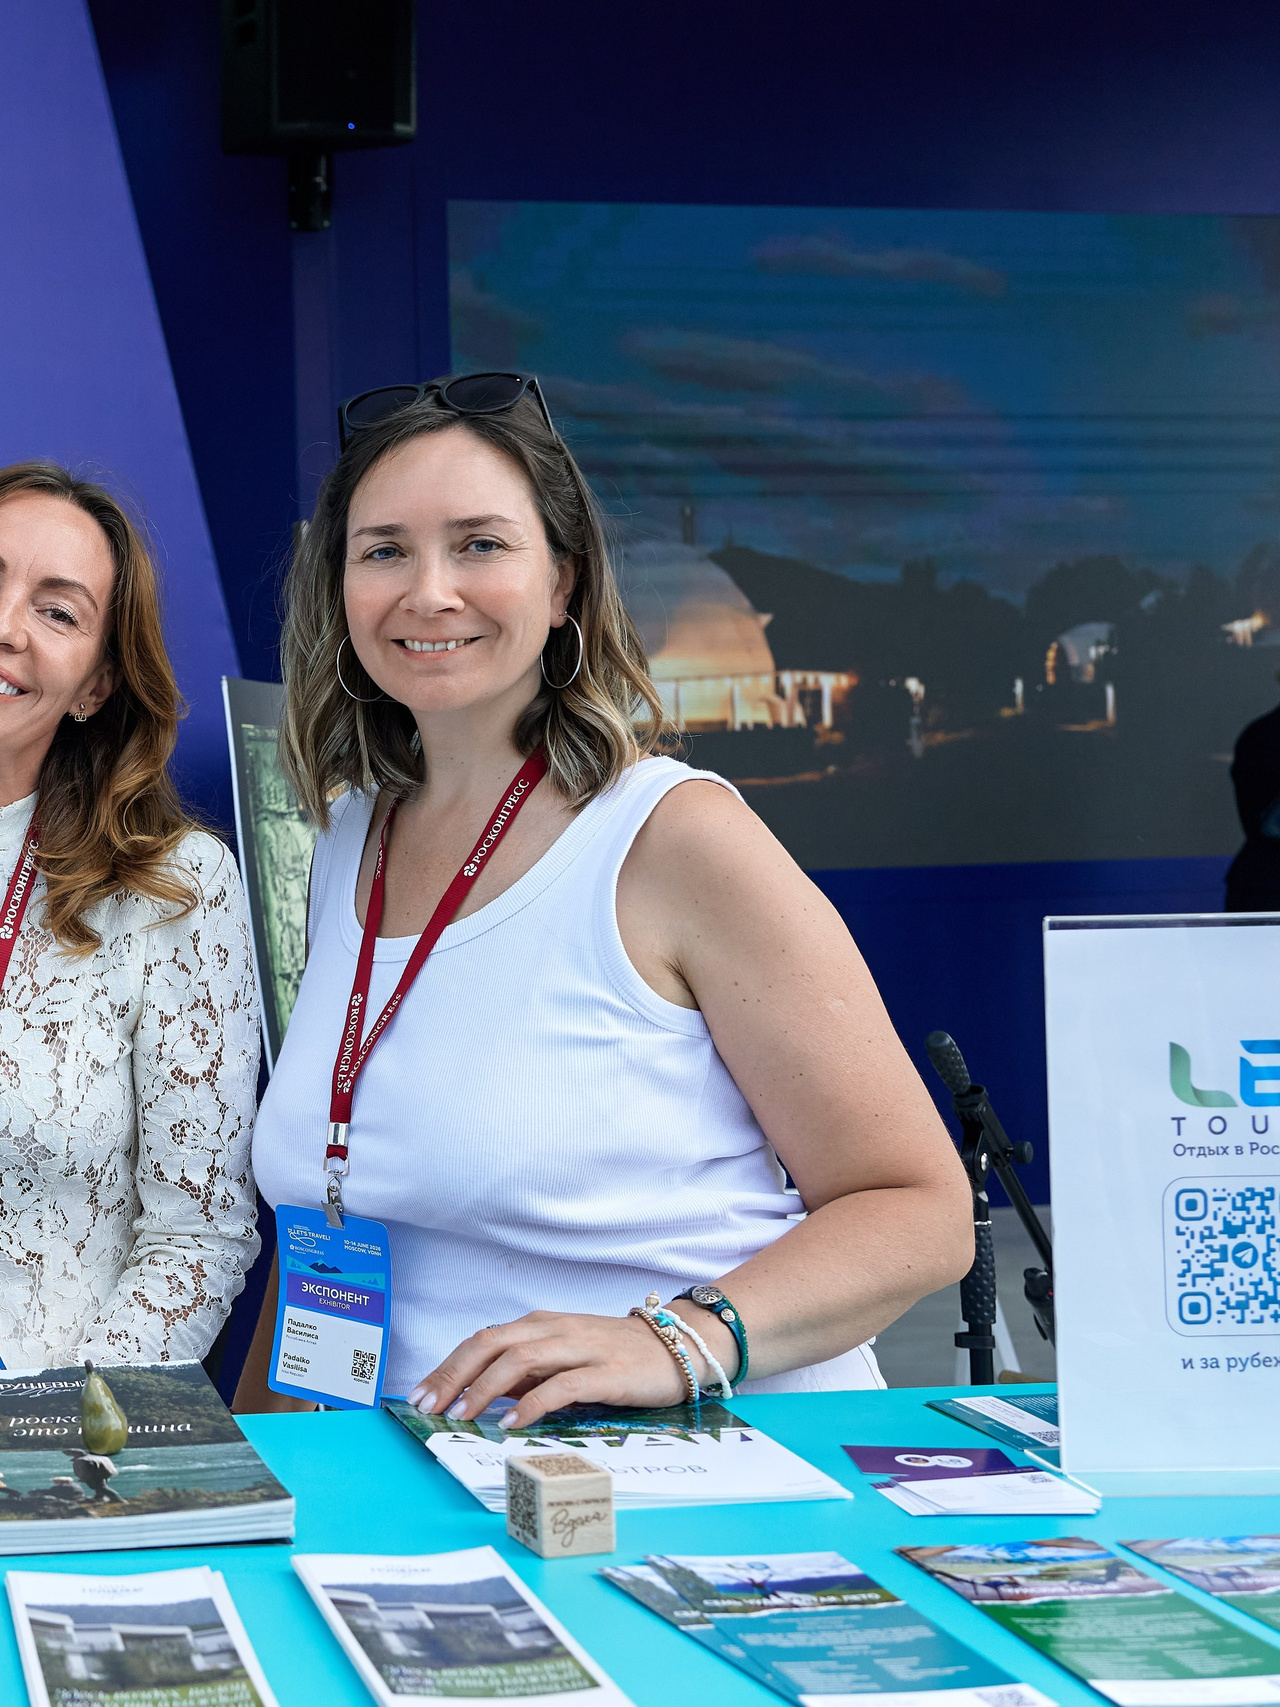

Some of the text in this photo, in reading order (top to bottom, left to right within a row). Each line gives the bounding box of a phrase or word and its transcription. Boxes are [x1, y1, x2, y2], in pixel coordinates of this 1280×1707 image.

[472, 778, 530, 864] РОСКОНГРЕСС
[4, 839, 40, 925] РОСКОНГРЕСС
[349, 993, 402, 1078] ROSCONGRESS
[1173, 1141, 1280, 1158] Отдых в Рос
[308, 1231, 331, 1241] TRAVEL!
[301, 1282, 370, 1306] ЭКСПОНЕНТ
[319, 1298, 351, 1311] EXHIBITOR
[287, 1318, 318, 1331] Падалко
[286, 1327, 319, 1340] Василиса
[283, 1352, 311, 1365] Padalko
[1181, 1356, 1194, 1370] и
[1199, 1356, 1220, 1370] за
[282, 1361, 308, 1373] Vasilisa
[13, 1427, 68, 1437] это
[607, 1464, 708, 1475] ЬТРОВ
